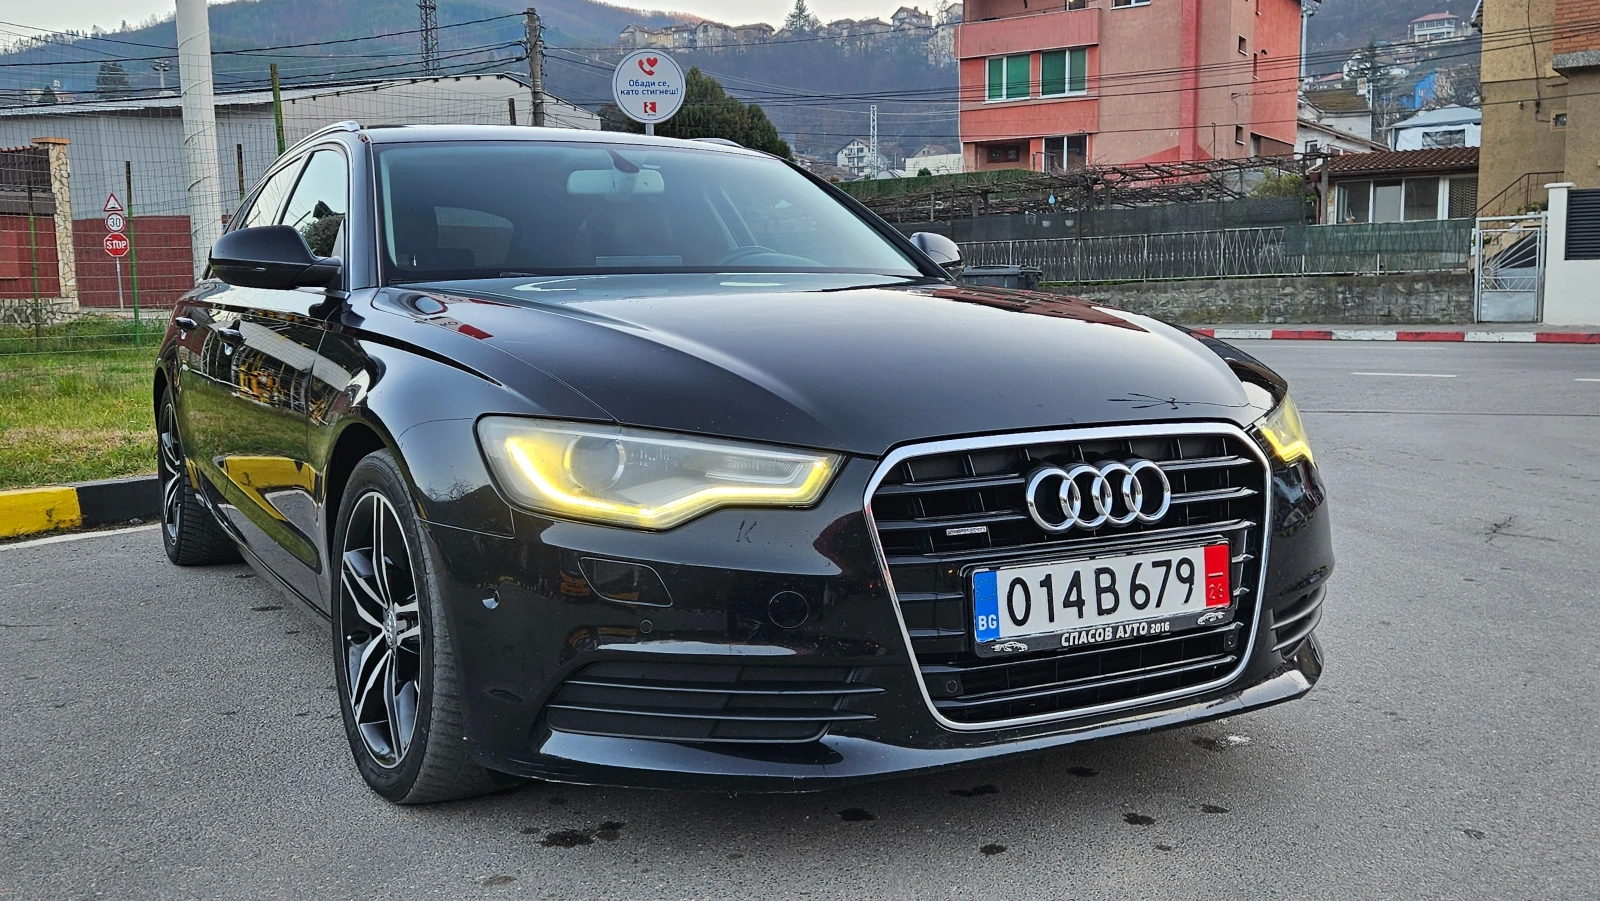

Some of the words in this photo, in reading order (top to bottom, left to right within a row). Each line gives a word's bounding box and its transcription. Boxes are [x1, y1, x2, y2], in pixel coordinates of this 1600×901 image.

[628, 79, 656, 88] Обади
[657, 80, 670, 88] се,
[641, 87, 679, 96] стигнеш!
[109, 217, 121, 228] 30
[106, 240, 127, 249] STOP
[978, 614, 997, 630] BG
[1007, 557, 1195, 627] 014B679
[1061, 627, 1113, 647] СПАСОВ
[1115, 621, 1148, 639] АУТО
[1150, 621, 1170, 634] 2016
